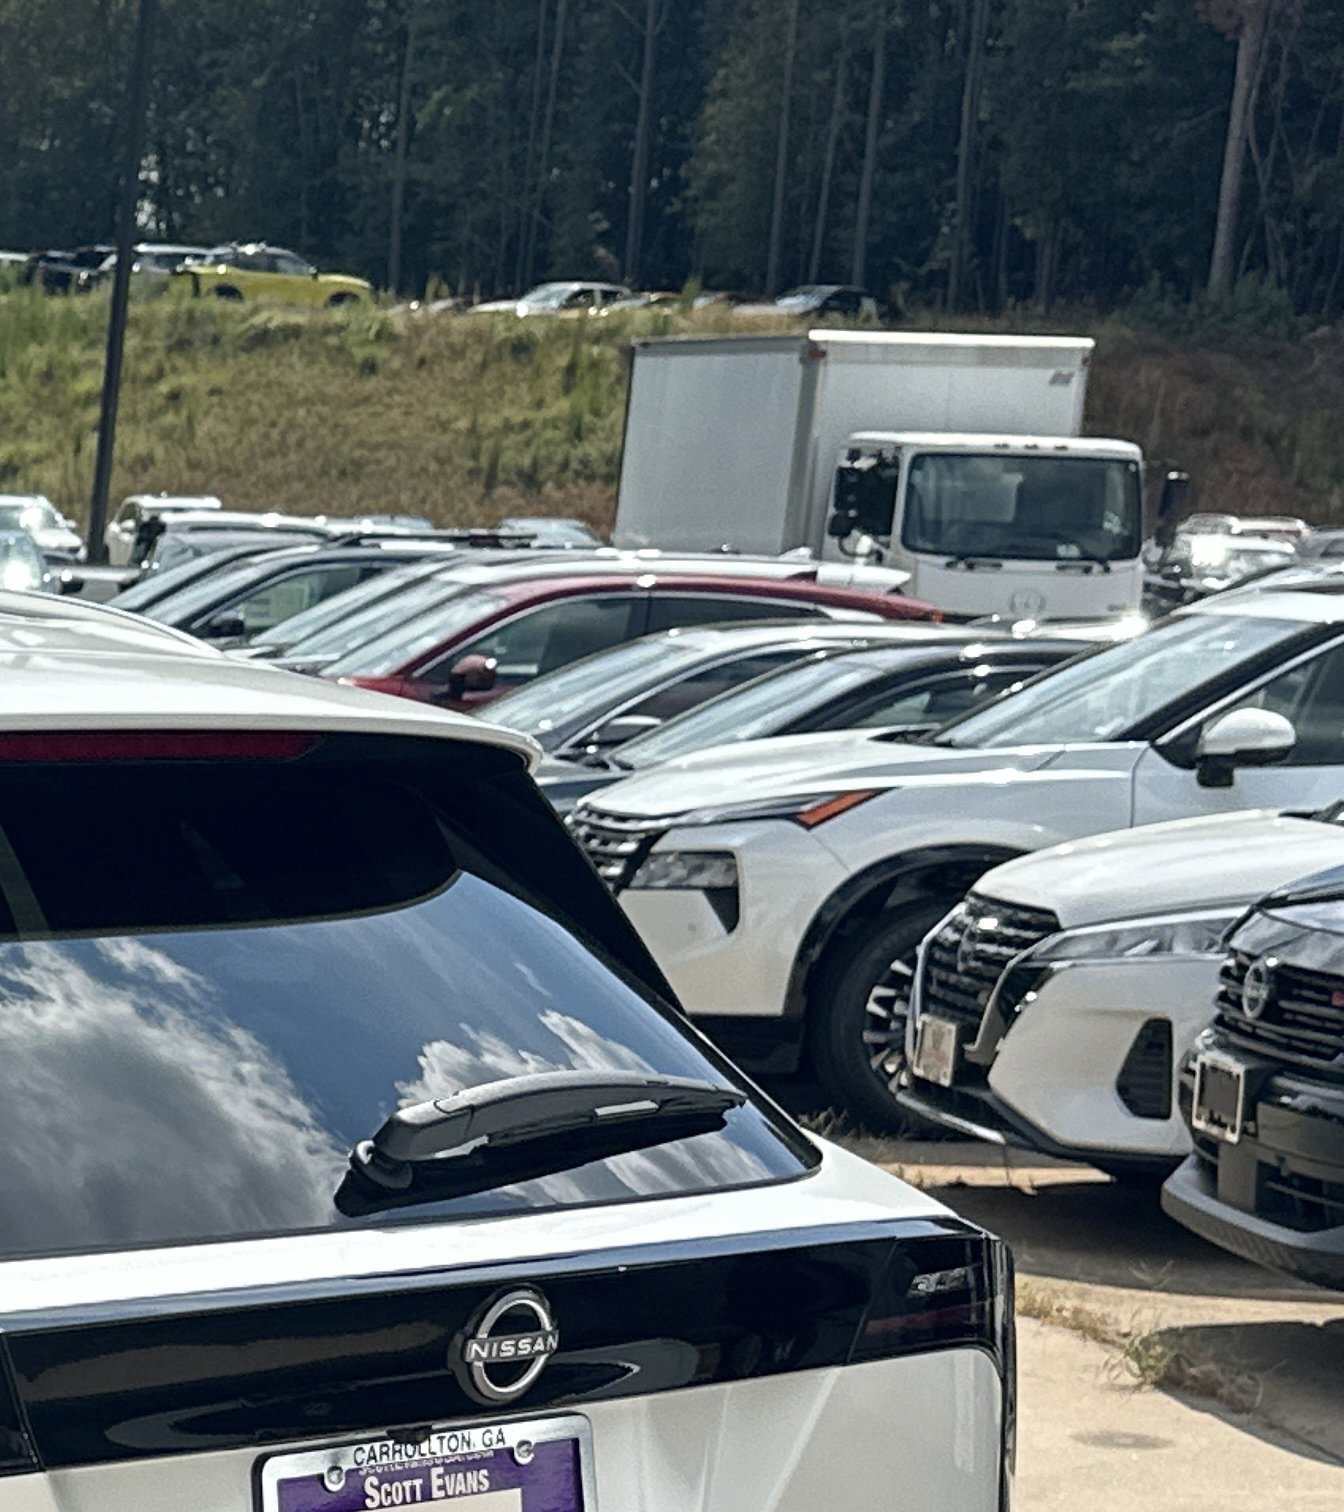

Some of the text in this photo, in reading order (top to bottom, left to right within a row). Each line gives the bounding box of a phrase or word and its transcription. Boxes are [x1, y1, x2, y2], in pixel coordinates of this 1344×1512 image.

[471, 1334, 558, 1358] NISSAN
[482, 1428, 506, 1448] GA
[364, 1467, 491, 1509] SCOTT EVANS
